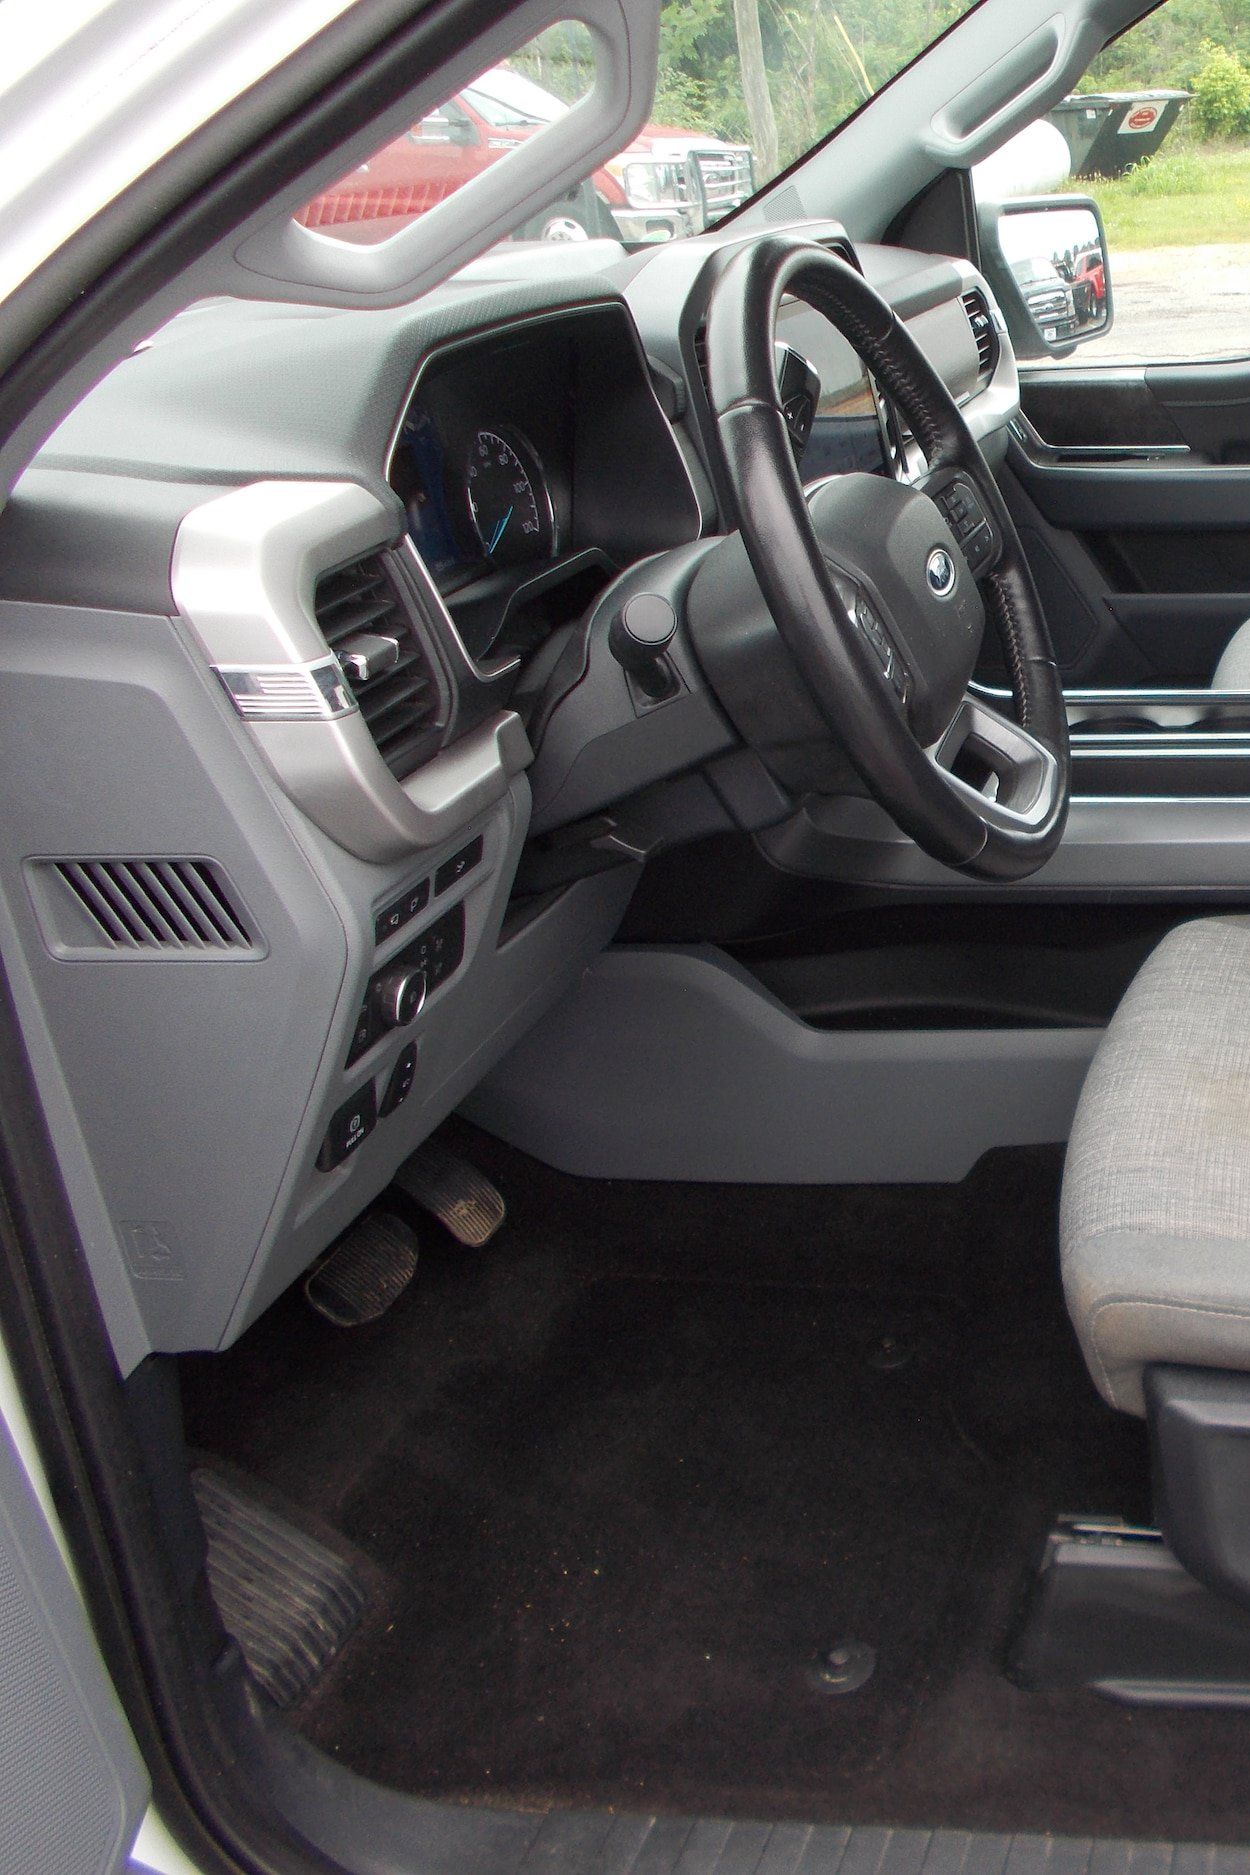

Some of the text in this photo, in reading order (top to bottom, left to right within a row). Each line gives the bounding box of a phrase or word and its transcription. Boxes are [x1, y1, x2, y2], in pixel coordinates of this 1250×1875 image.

[498, 453, 509, 466] 80
[513, 480, 526, 494] 100
[522, 520, 534, 535] 120
